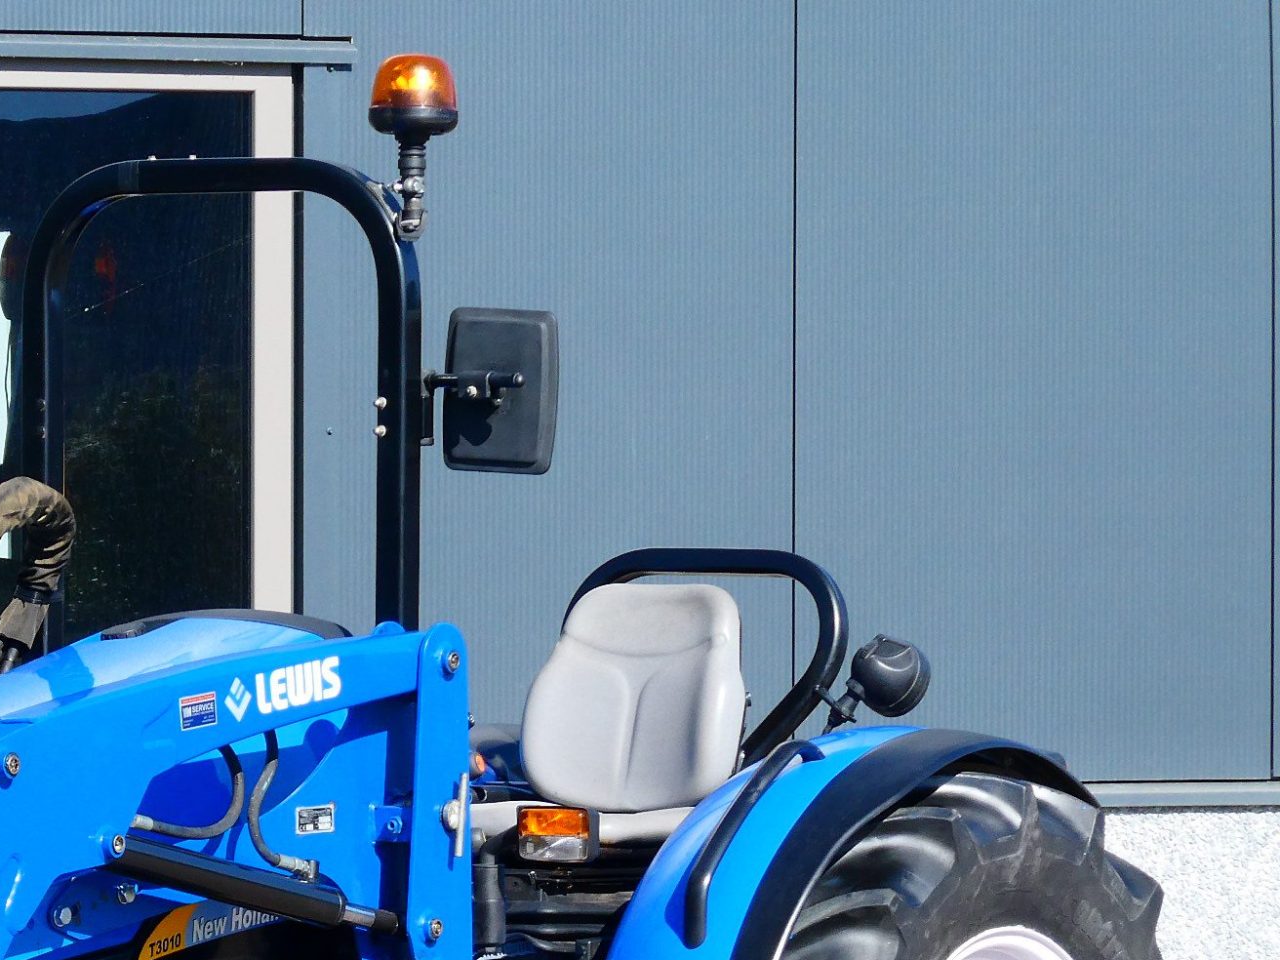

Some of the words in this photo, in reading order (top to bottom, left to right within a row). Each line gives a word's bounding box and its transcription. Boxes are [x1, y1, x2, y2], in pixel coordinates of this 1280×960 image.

[255, 656, 342, 715] LEWIS
[191, 702, 215, 713] SERVICE
[149, 933, 181, 957] T3010
[192, 916, 227, 943] New
